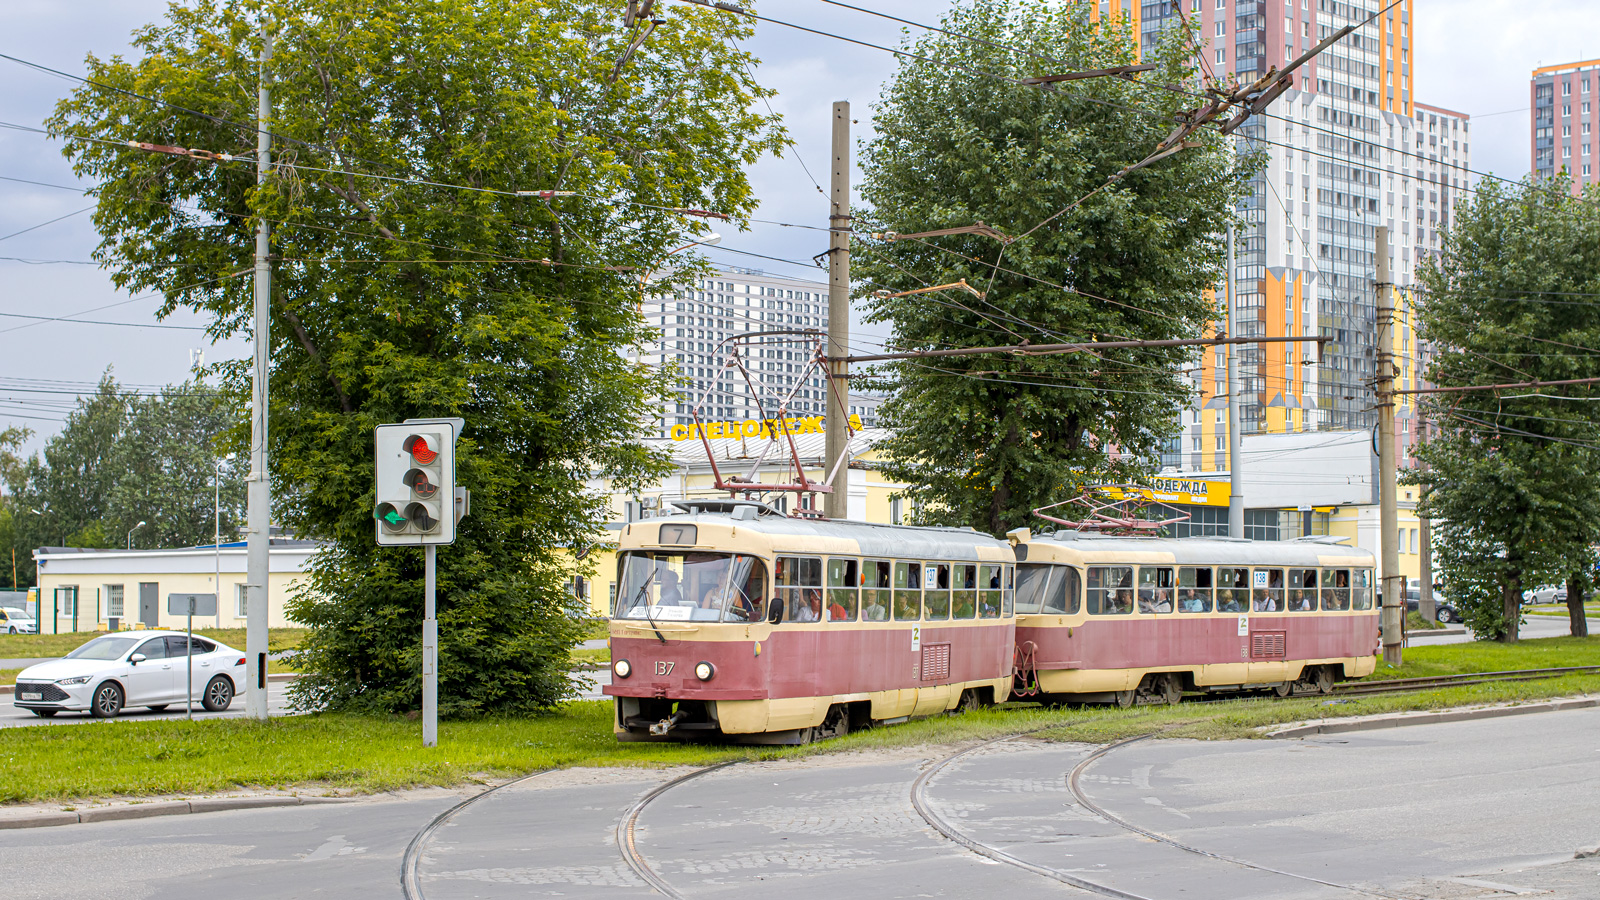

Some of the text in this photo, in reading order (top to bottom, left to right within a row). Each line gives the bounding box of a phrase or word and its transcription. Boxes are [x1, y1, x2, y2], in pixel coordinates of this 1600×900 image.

[670, 413, 864, 442] СПЕЦОДЕЖА
[673, 529, 684, 544] 7
[926, 569, 936, 581] 137
[1256, 572, 1266, 582] 138
[656, 607, 664, 619] 7
[654, 661, 675, 676] 137
